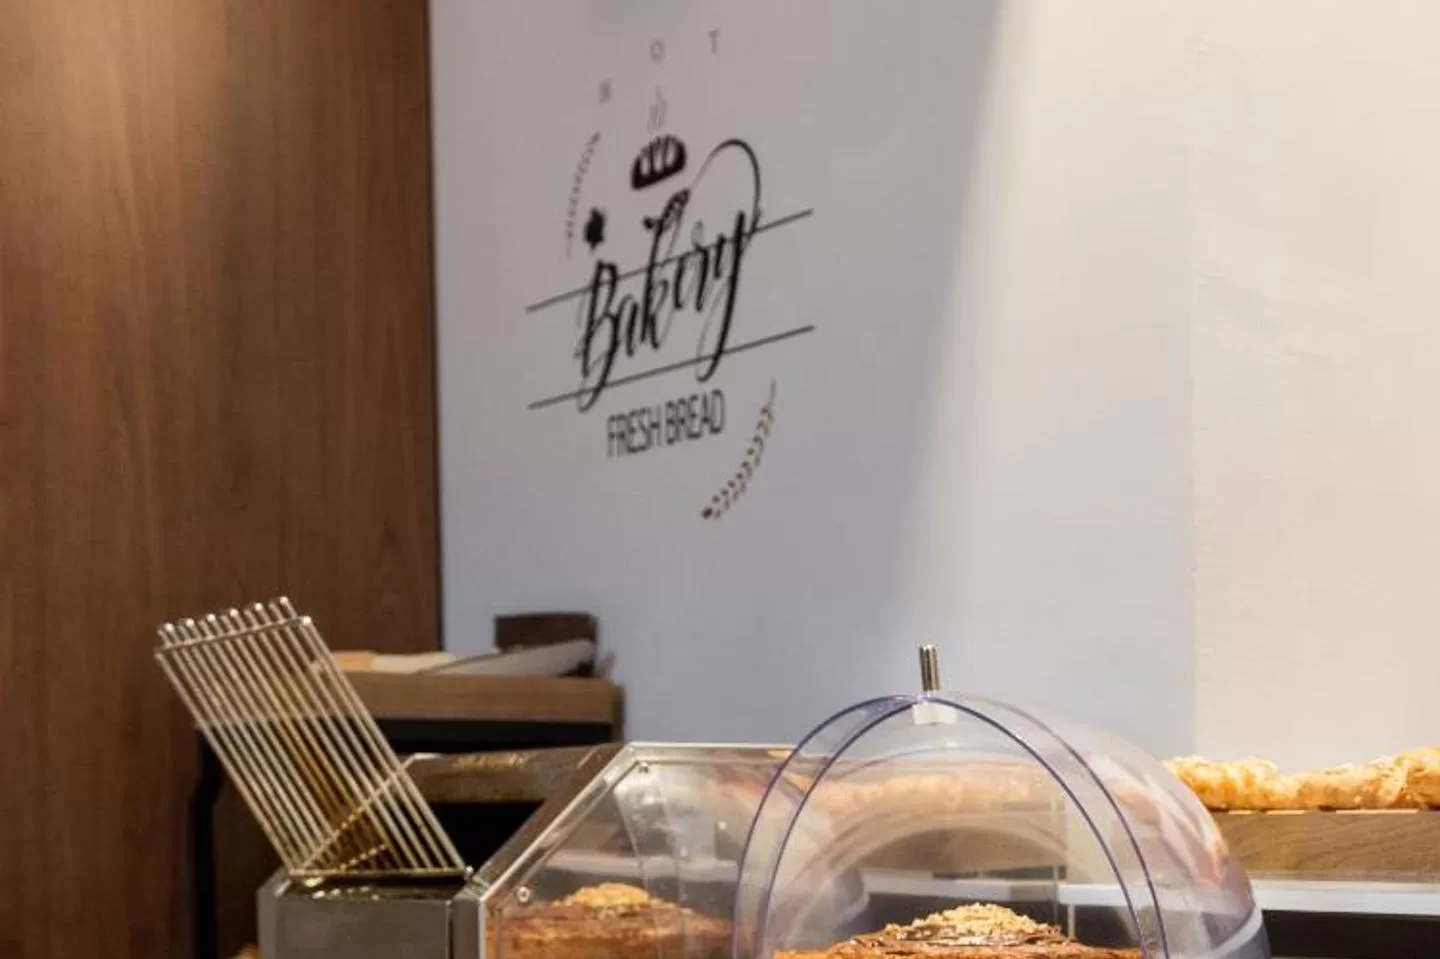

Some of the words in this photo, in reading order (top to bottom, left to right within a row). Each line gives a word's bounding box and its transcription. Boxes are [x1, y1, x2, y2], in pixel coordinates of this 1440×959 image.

[574, 138, 761, 413] Bakery
[606, 404, 662, 458] FRESH
[665, 388, 726, 445] BREAD
